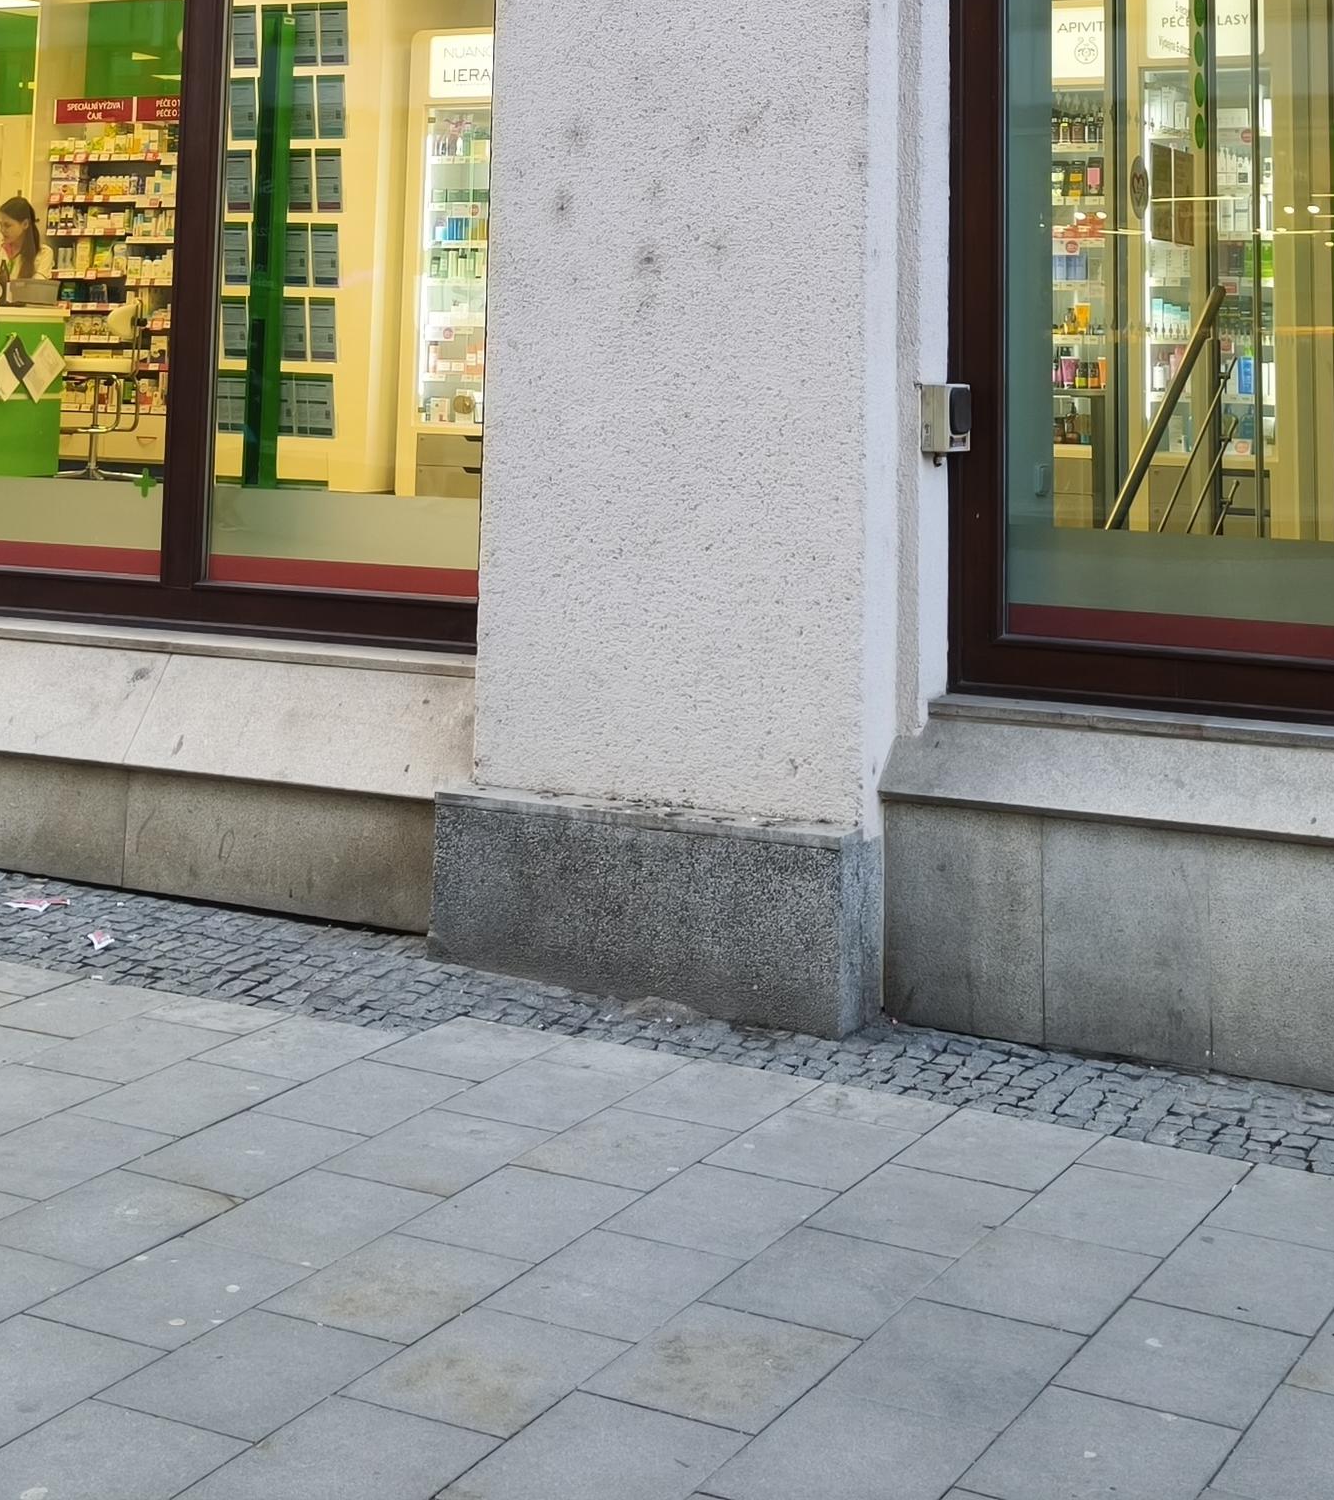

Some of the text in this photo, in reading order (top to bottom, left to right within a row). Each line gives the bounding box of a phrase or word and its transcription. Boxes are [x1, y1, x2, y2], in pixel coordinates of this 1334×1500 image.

[1217, 14, 1249, 26] LASY
[1057, 21, 1106, 33] APIVIT
[443, 45, 492, 59] NUANC
[443, 68, 491, 83] LIERA
[87, 111, 102, 121] ČAJE
